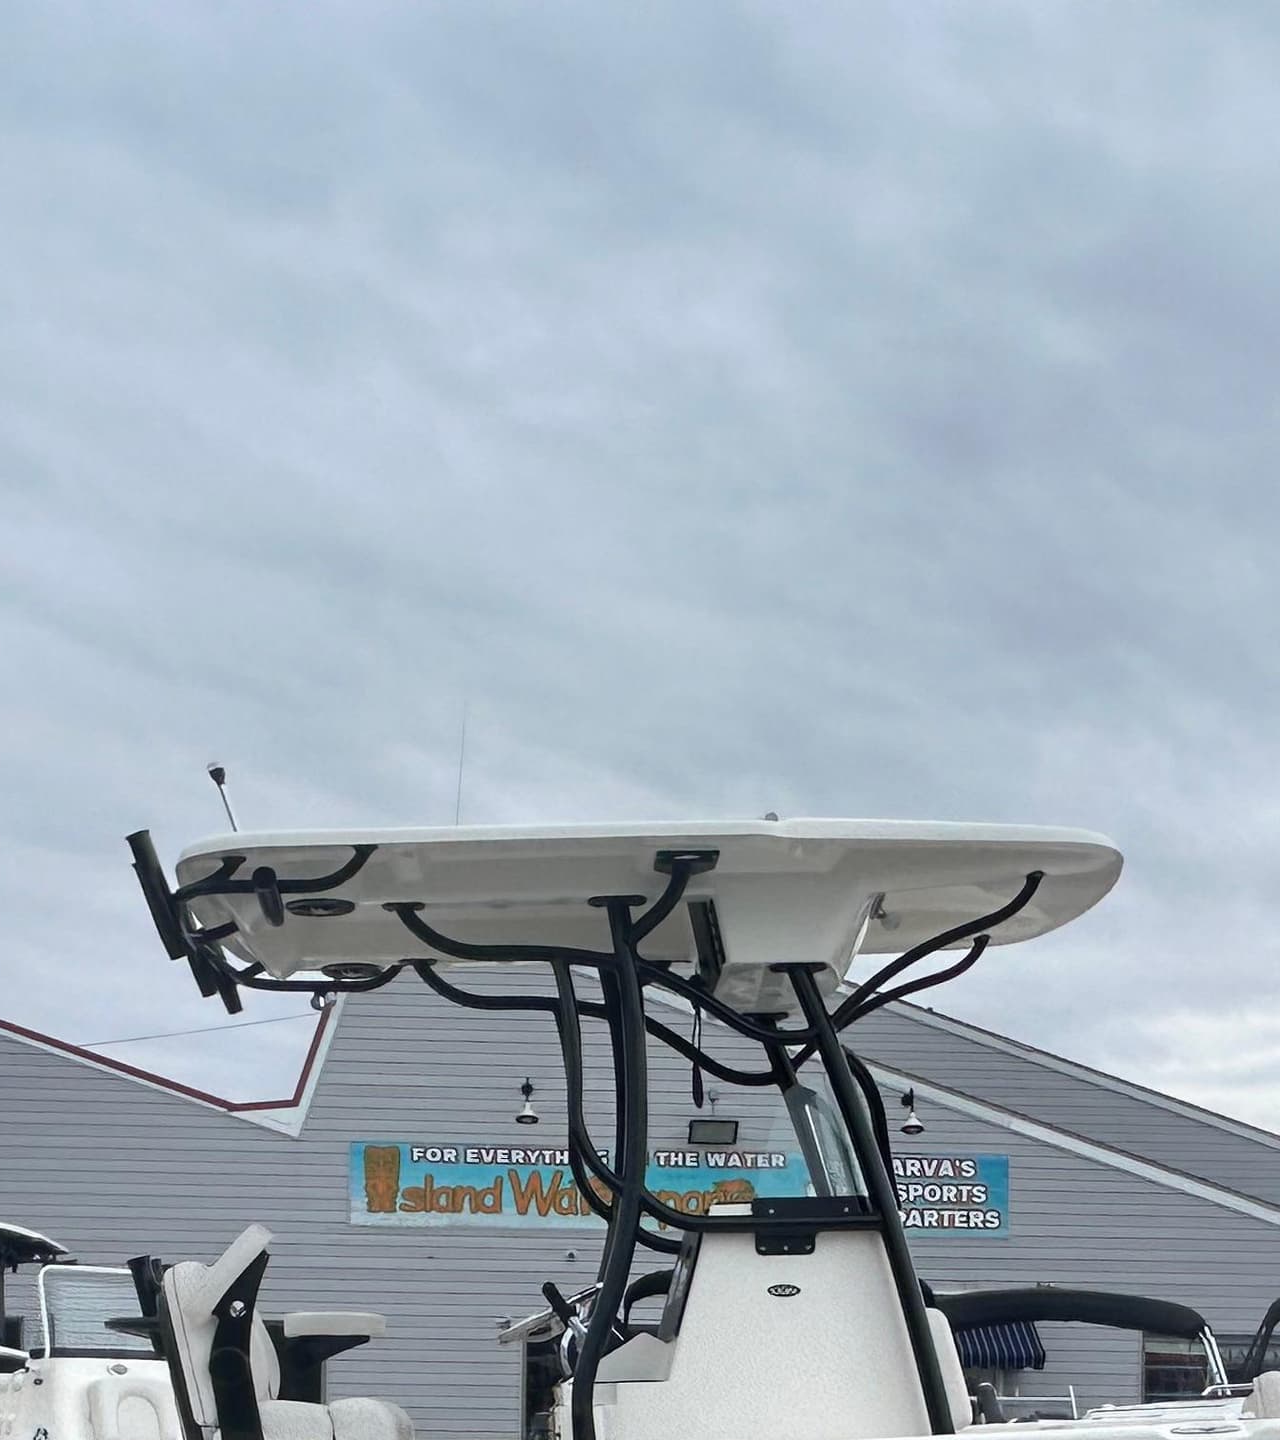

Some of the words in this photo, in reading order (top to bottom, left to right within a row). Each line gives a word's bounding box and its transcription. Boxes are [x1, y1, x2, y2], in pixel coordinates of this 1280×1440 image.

[411, 1146, 458, 1164] FOR
[654, 1150, 700, 1168] THE
[705, 1150, 787, 1169] WATER
[892, 1157, 977, 1178] ARVA'S
[896, 1183, 989, 1203] SPORTS
[899, 1208, 1001, 1229] ARTERS
